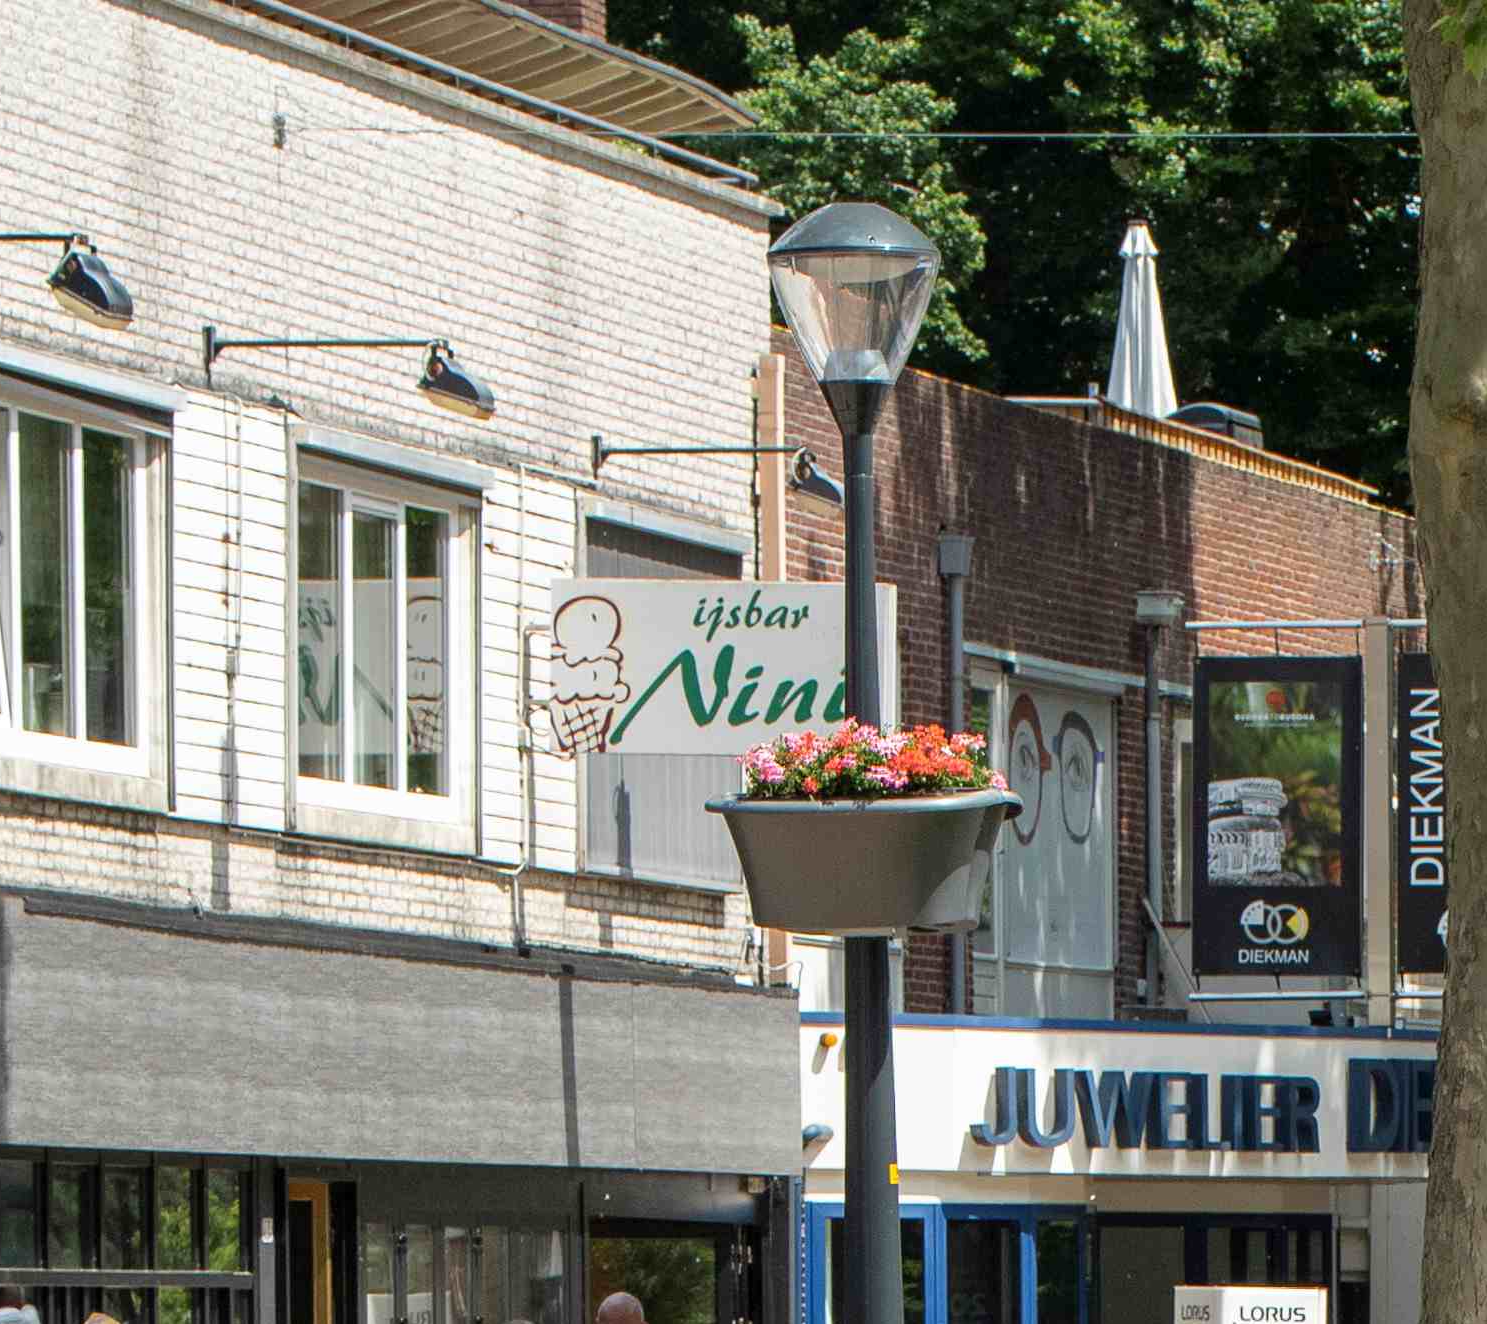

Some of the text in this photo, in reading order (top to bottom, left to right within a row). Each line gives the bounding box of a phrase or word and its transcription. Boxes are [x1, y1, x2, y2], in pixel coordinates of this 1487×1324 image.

[693, 589, 809, 642] ijsbar
[1410, 688, 1444, 886] DIEKMAN
[1238, 949, 1310, 964] DIEKMAN
[969, 1066, 1321, 1153] JUWELIER
[1181, 1305, 1210, 1321] LORUS
[1240, 1306, 1306, 1322] LORUS
